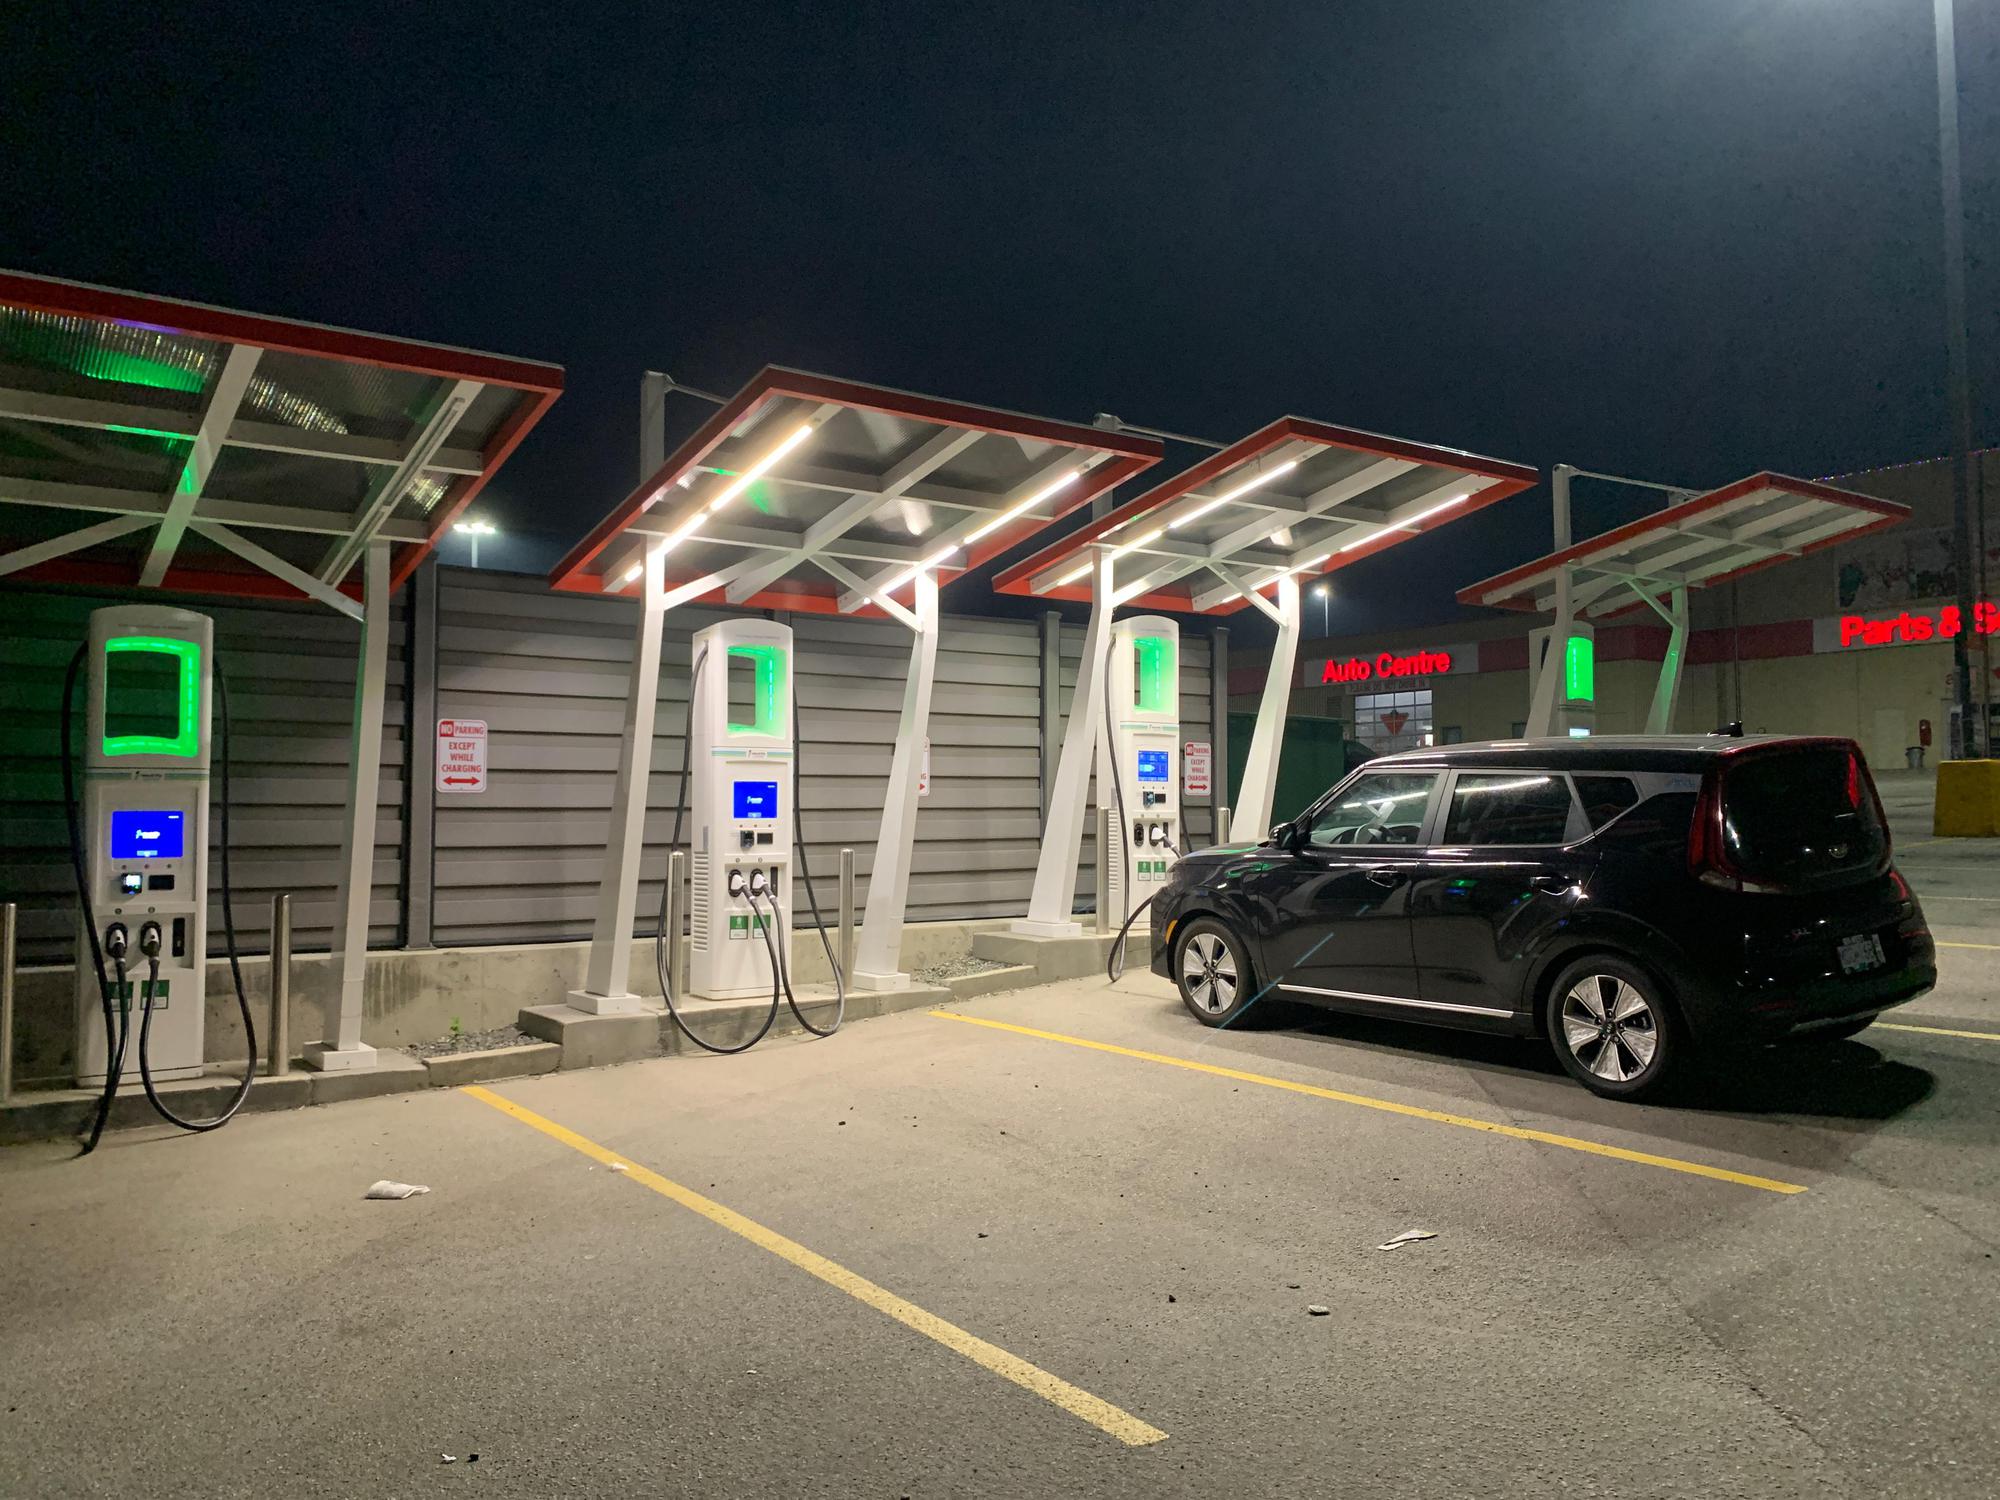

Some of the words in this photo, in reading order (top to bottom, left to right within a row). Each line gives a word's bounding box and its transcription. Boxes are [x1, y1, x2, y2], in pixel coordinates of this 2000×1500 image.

[1840, 612, 1934, 647] Parts
[1322, 658, 1371, 683] Auto
[1375, 651, 1450, 678] Centre
[441, 723, 453, 734] NO
[455, 726, 484, 735] PARKING
[448, 742, 476, 750] EXCEPT
[450, 753, 474, 761] WHILE
[441, 764, 482, 773] CHARGING
